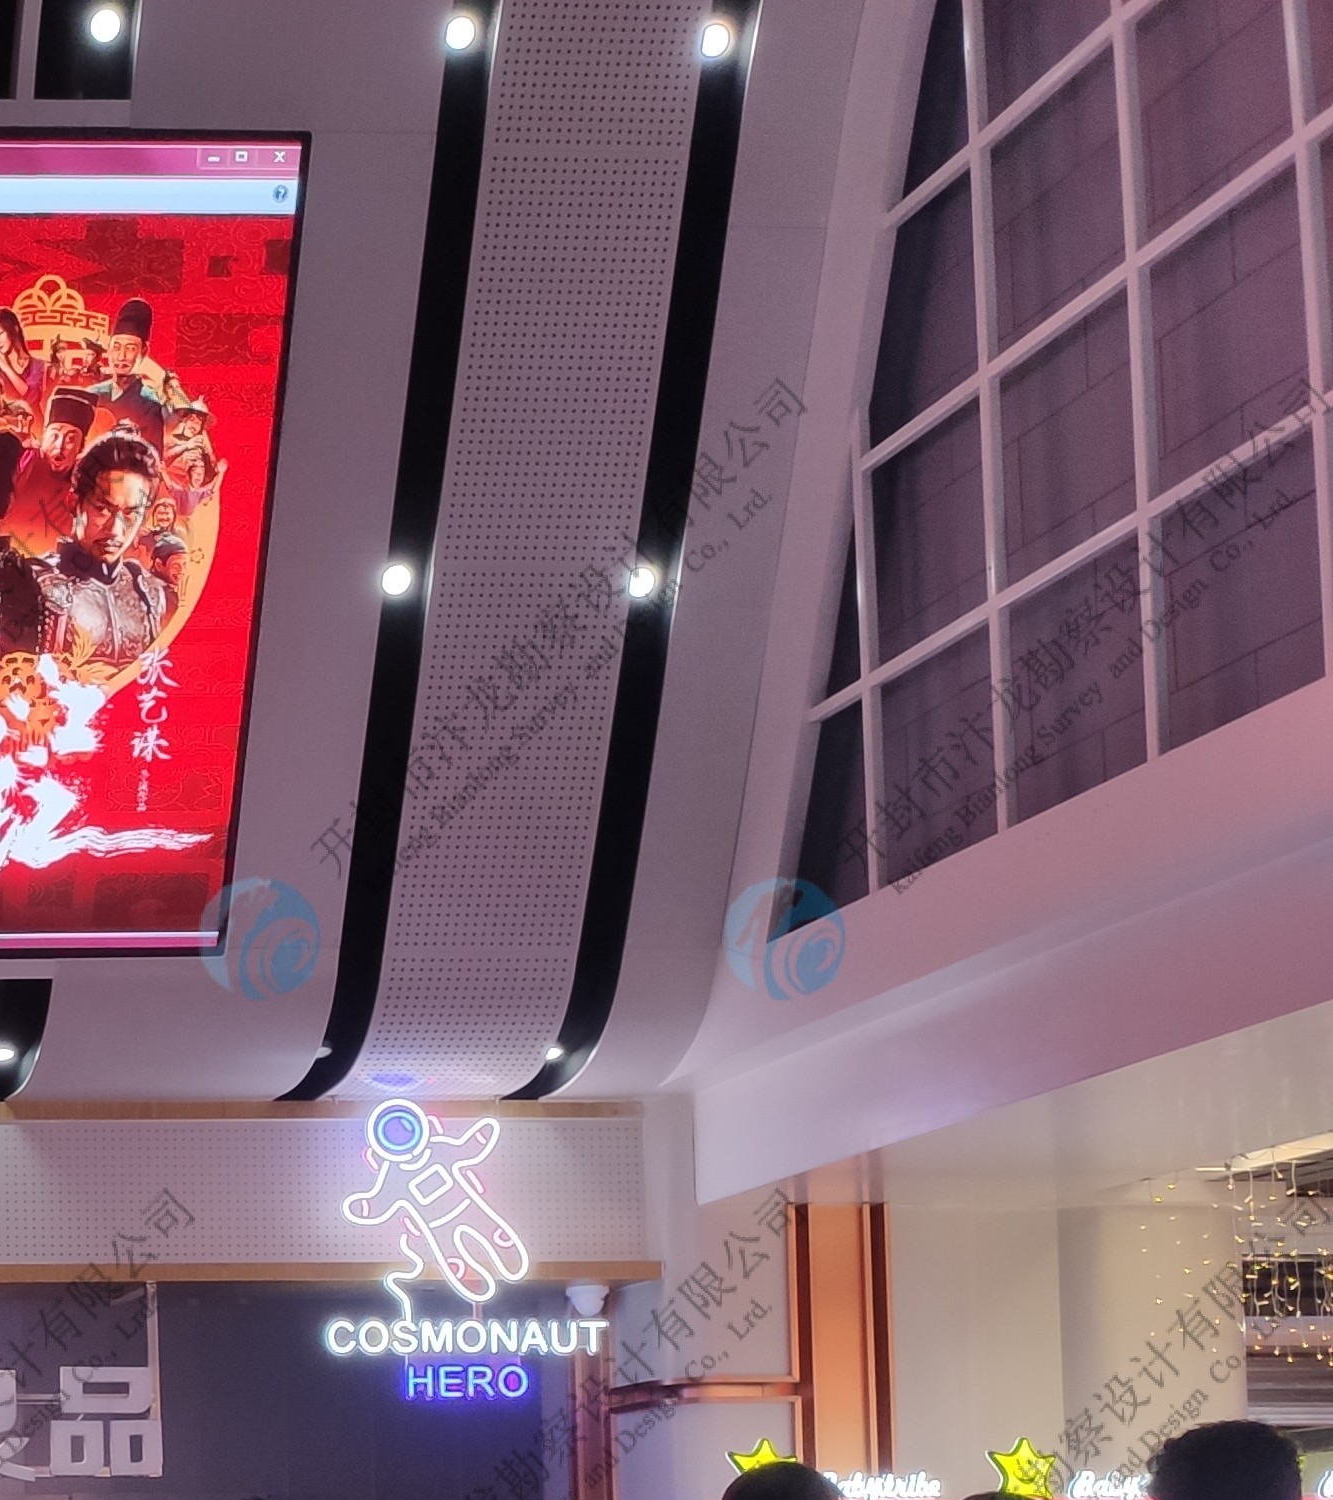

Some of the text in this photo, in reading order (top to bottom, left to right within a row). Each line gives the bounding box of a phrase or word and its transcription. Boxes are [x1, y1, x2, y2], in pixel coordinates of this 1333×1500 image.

[130, 647, 181, 763] 张艺谋
[326, 1319, 609, 1356] COSMONAUT
[406, 1364, 530, 1399] HERO
